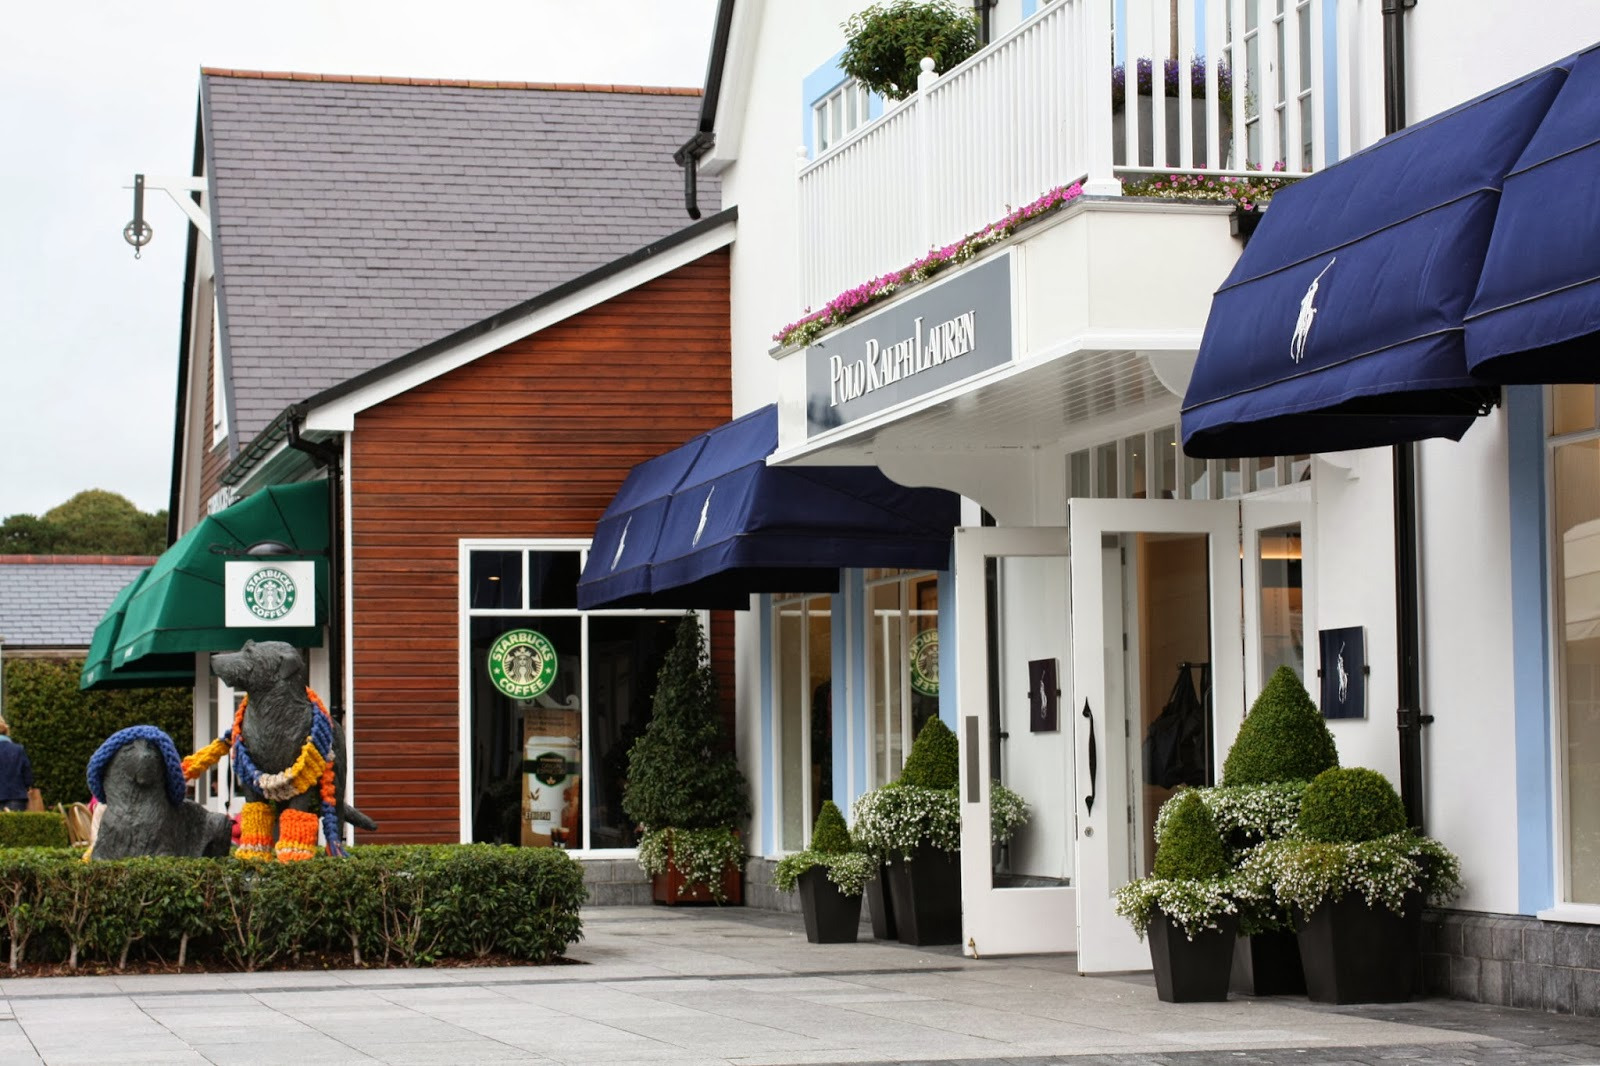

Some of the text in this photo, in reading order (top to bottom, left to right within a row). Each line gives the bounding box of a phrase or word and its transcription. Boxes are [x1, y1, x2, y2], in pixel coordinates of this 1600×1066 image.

[866, 338, 915, 393] RALPH
[914, 310, 976, 373] LAUREN
[246, 569, 295, 593] STARBUCKS
[251, 604, 289, 619] COFFEE
[492, 632, 554, 662] STARBUCKS
[499, 678, 547, 696] COFFEE
